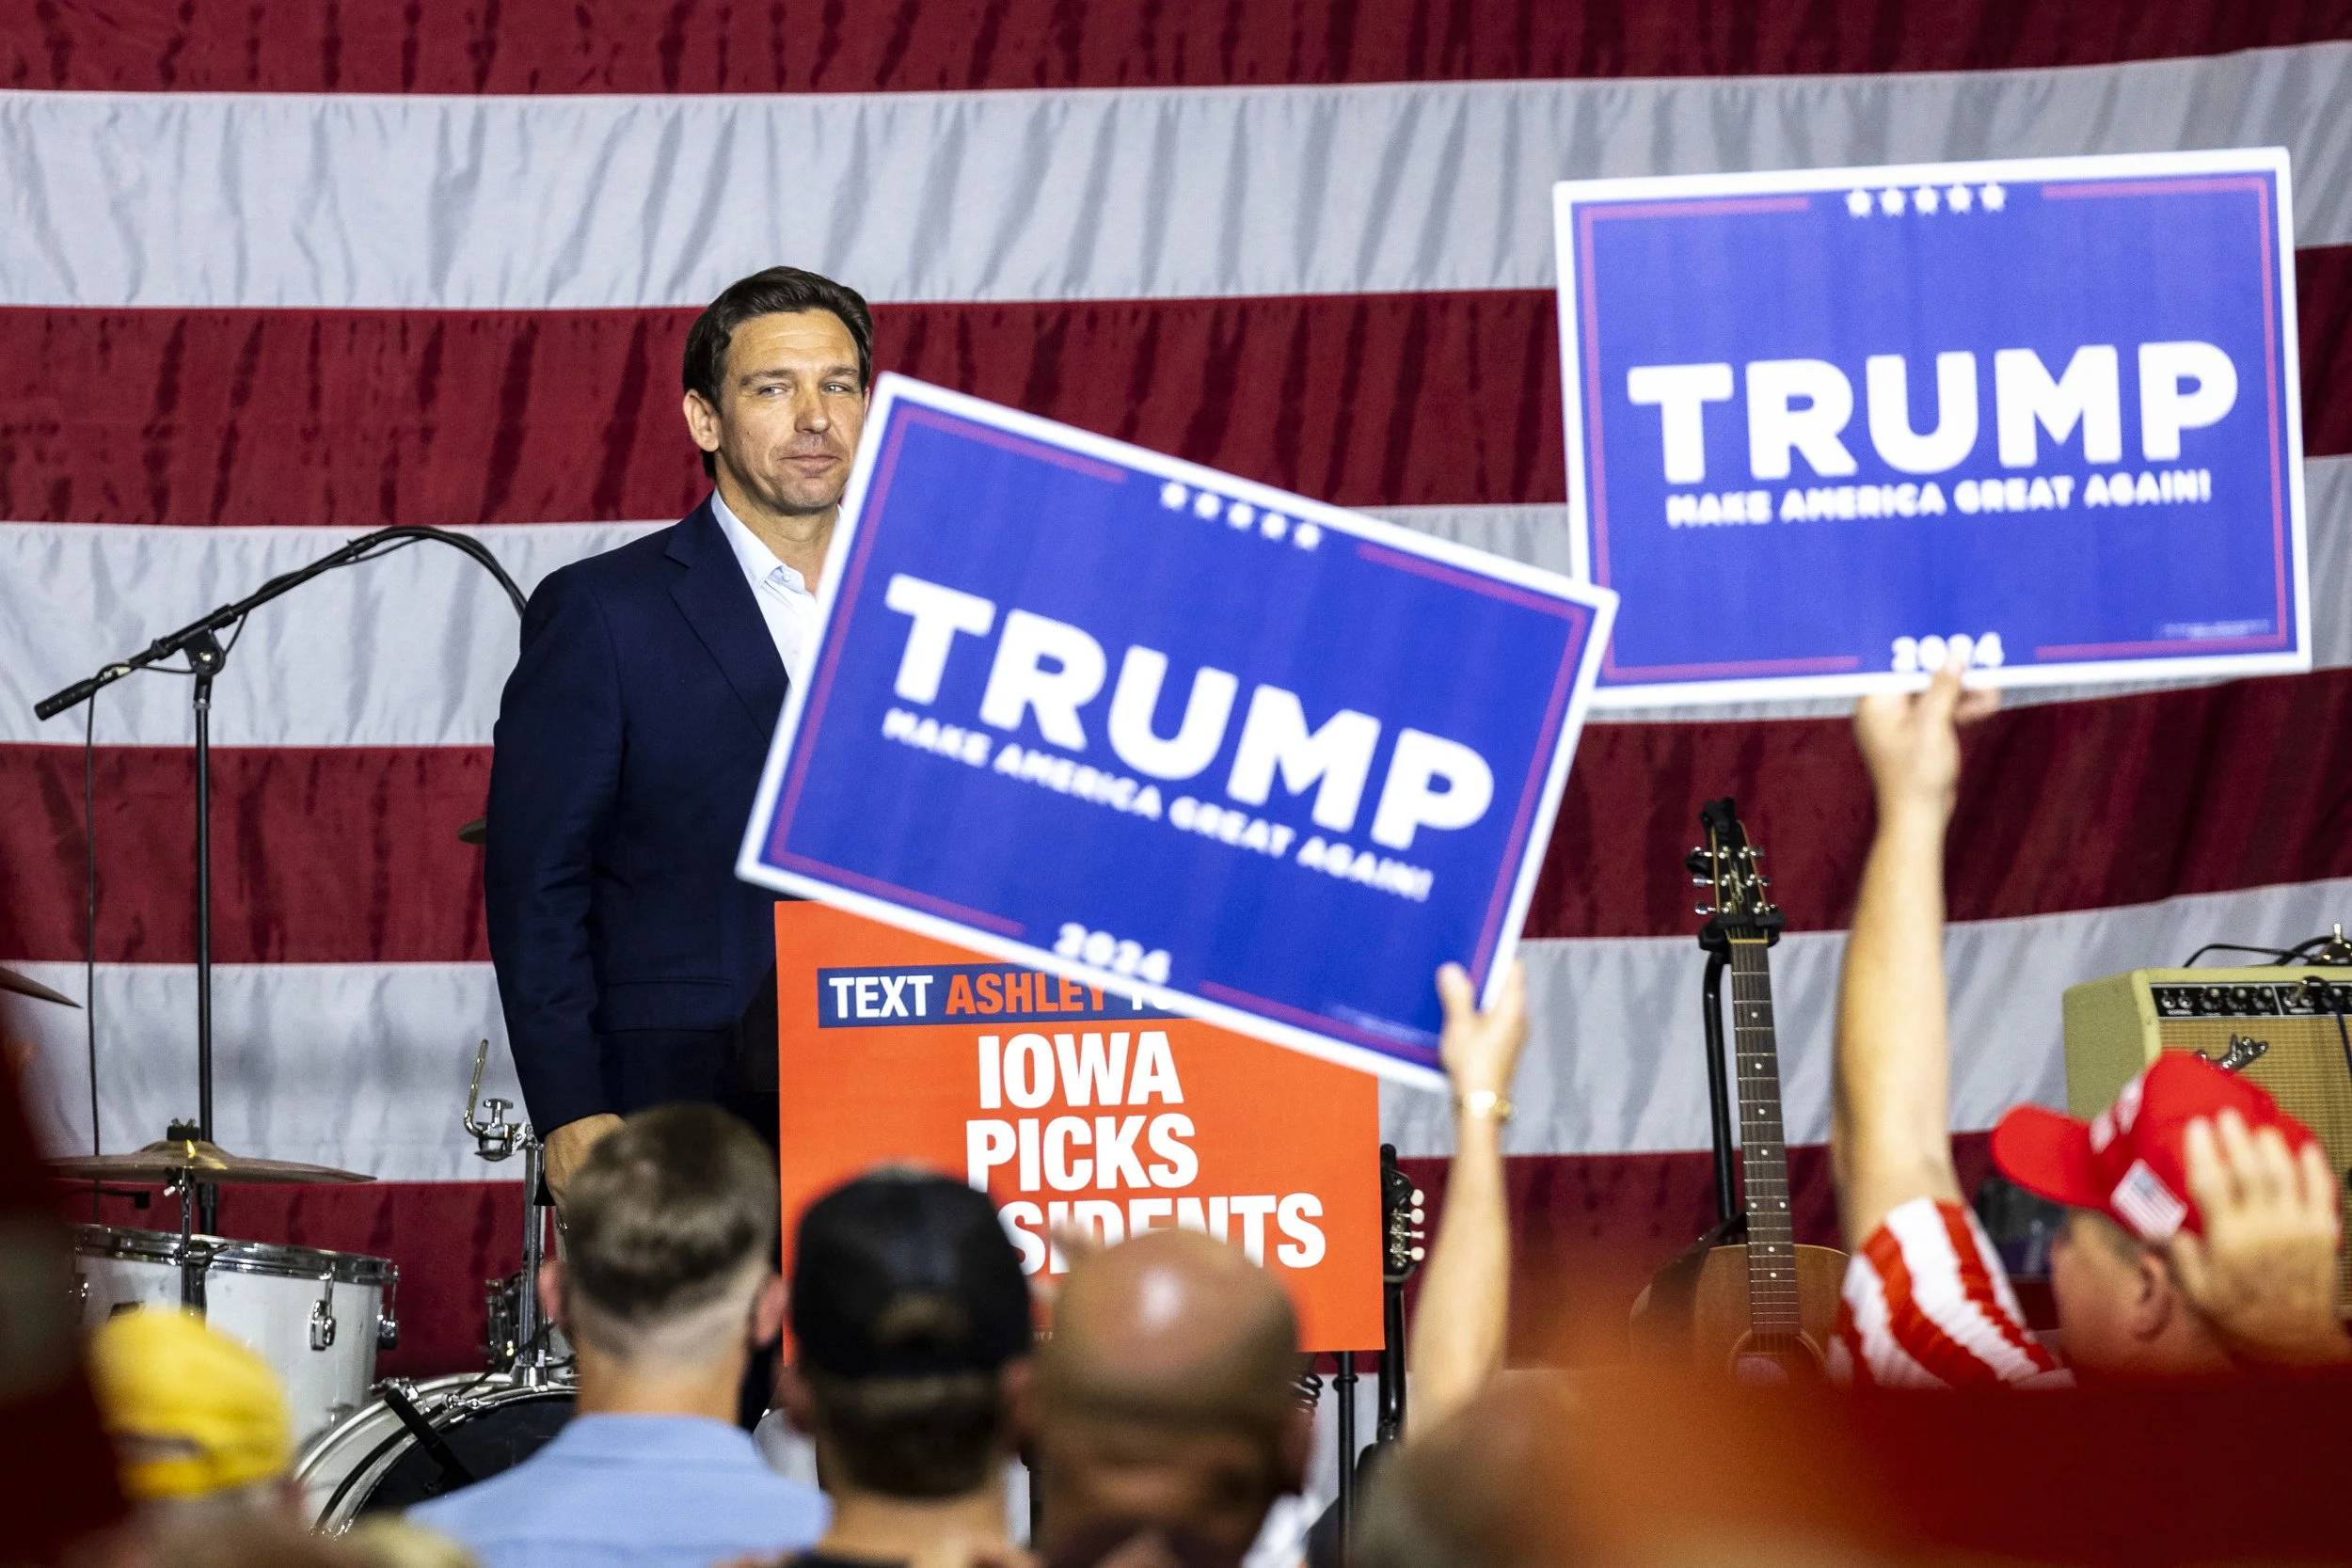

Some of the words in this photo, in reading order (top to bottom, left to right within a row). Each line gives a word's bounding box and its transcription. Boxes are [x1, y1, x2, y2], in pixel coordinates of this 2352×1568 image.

[1627, 341, 2238, 484] TRUMP
[1664, 491, 1773, 529] MAKE
[1779, 482, 1947, 523] AMERICA
[1953, 475, 2075, 515] GREAT
[2083, 468, 2213, 508] AGAIN!
[885, 574, 1495, 850] TRUMP
[882, 708, 993, 768] MAKE
[993, 743, 1164, 820] AMERICA
[1168, 795, 1295, 858] GREAT
[1296, 835, 1434, 902] AGAIN!
[1056, 923, 1170, 984] 2024
[829, 975, 933, 1018] TEXT
[946, 972, 1106, 1015] ASHLEY
[978, 1031, 1184, 1109] IOWA
[966, 1113, 1199, 1192] PICKS
[997, 1193, 1326, 1275] SIDNTS
